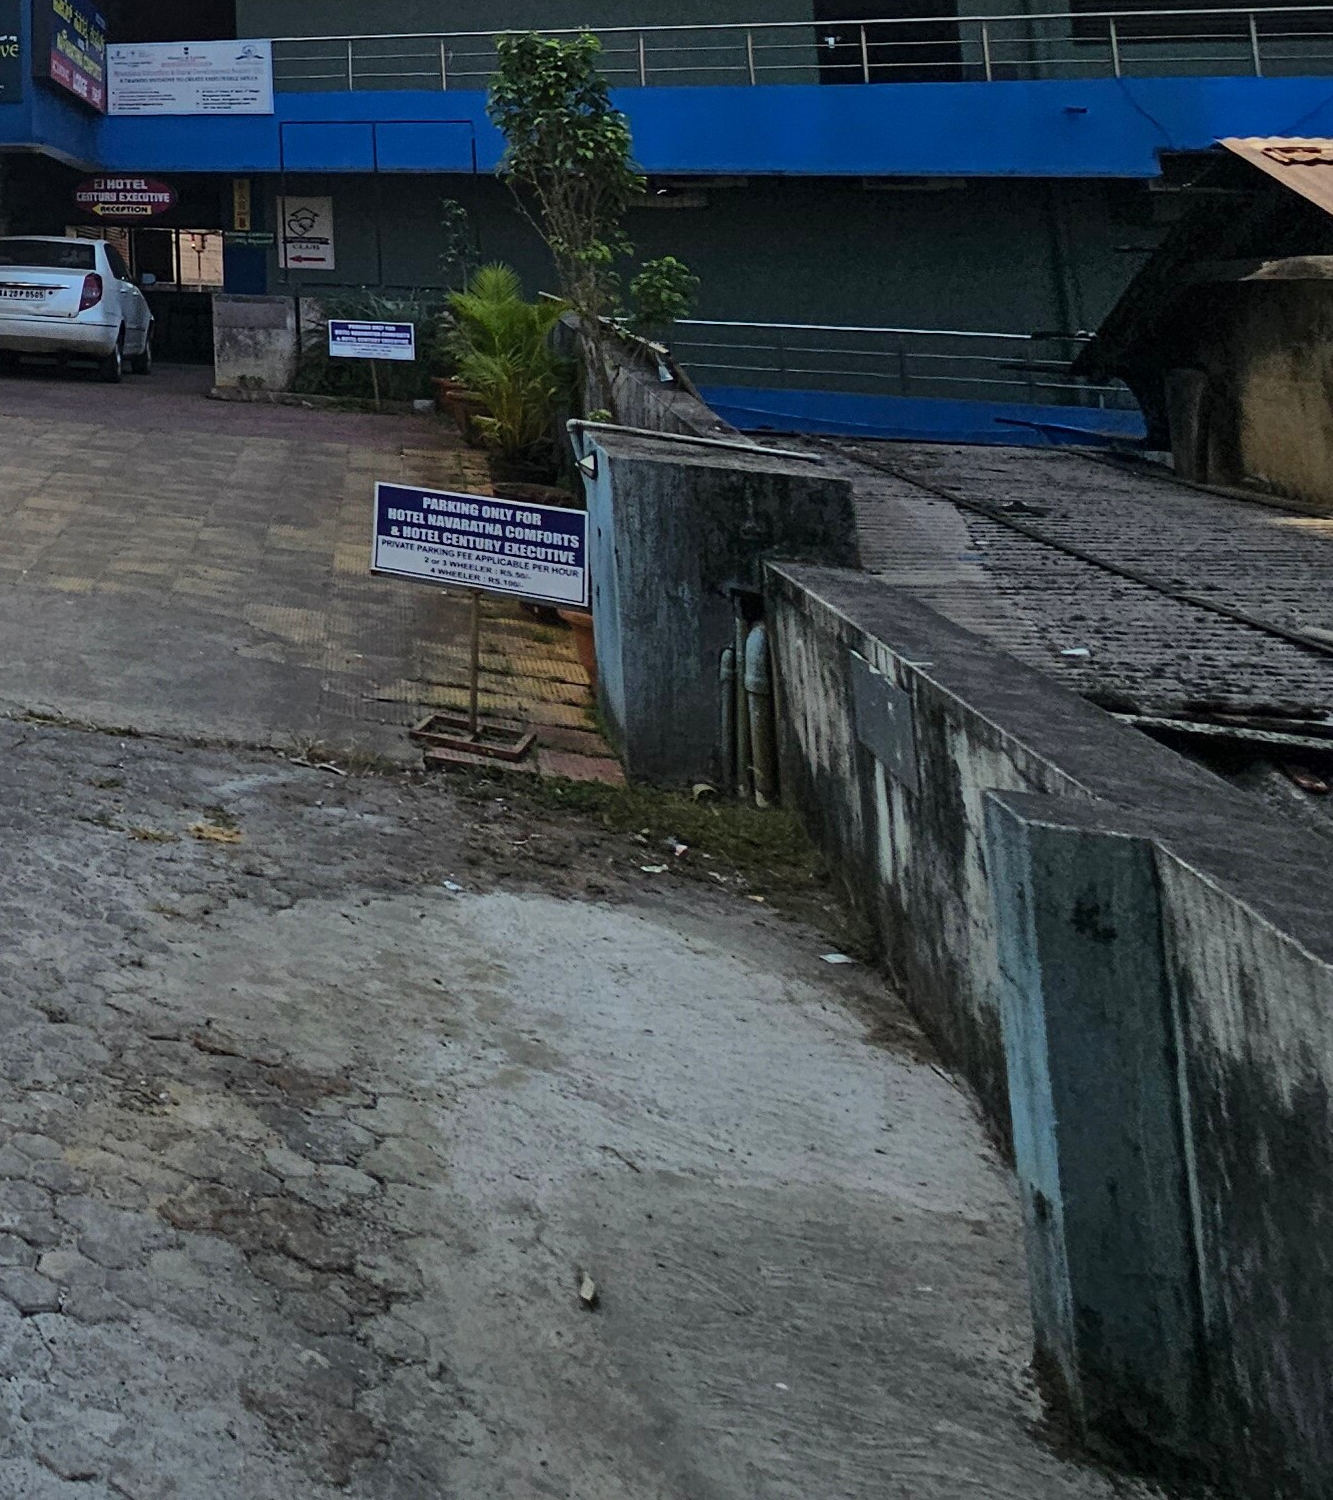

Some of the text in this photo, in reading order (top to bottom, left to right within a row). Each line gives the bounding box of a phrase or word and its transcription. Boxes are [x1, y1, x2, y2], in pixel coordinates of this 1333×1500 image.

[106, 179, 148, 190] HOTEL
[119, 192, 170, 203] EXECUTIVE
[423, 496, 542, 526] PARKING ONLY FOR
[387, 508, 580, 549] HOTEL NAVARATNA COMFORTS
[390, 526, 576, 565] & HOTEL CENTURY EXECUTIVE
[381, 539, 579, 578] PRIVATE PARKING FEE APPLICABLE PER HOUR
[442, 558, 447, 566] 3
[449, 560, 493, 574] WHEELER
[437, 568, 481, 582] WHEELER
